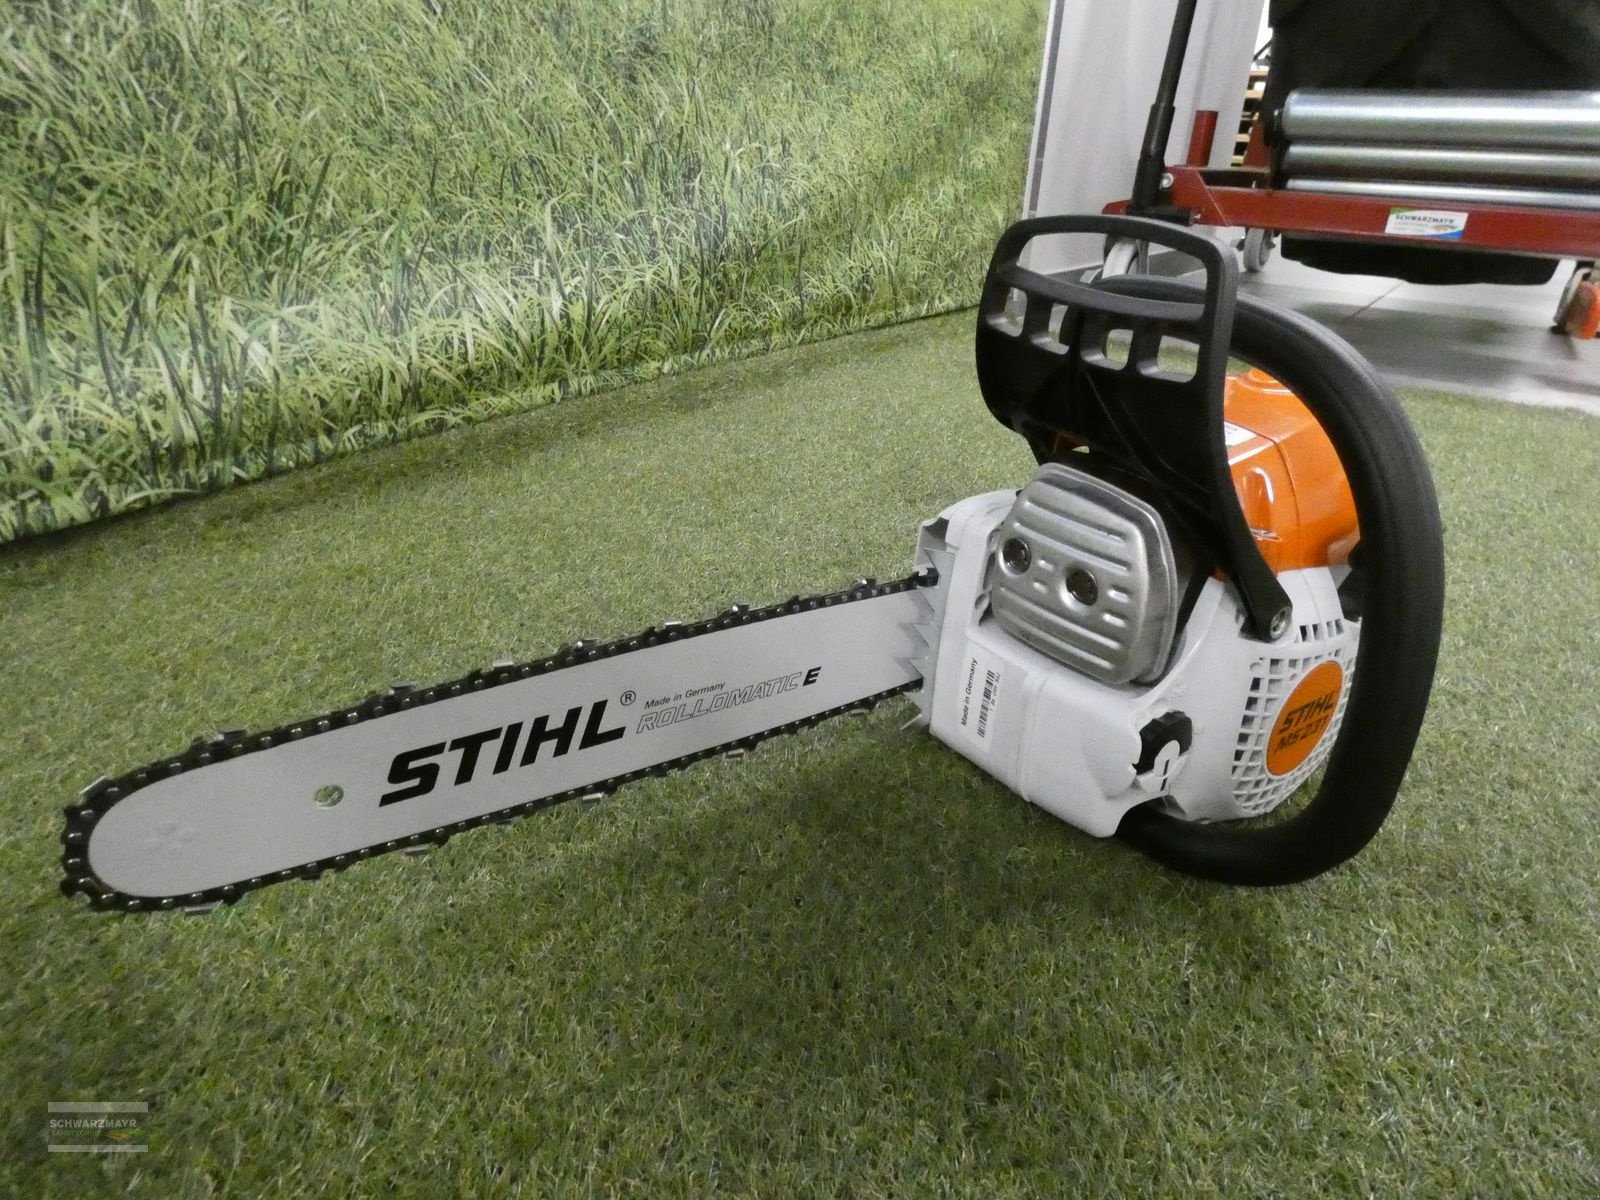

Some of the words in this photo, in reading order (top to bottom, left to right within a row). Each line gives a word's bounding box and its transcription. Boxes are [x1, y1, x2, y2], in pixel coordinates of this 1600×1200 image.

[1395, 214, 1455, 224] SCHWARZMAYR
[965, 658, 978, 695] Germany
[636, 671, 803, 734] ROLLOMATIC
[803, 666, 822, 686] E
[644, 696, 671, 709] Made
[674, 692, 683, 702] in
[685, 682, 726, 698] Germany
[964, 696, 971, 705] in
[961, 705, 969, 726] Made
[1279, 690, 1335, 734] STIHL
[379, 699, 627, 807] STIHL
